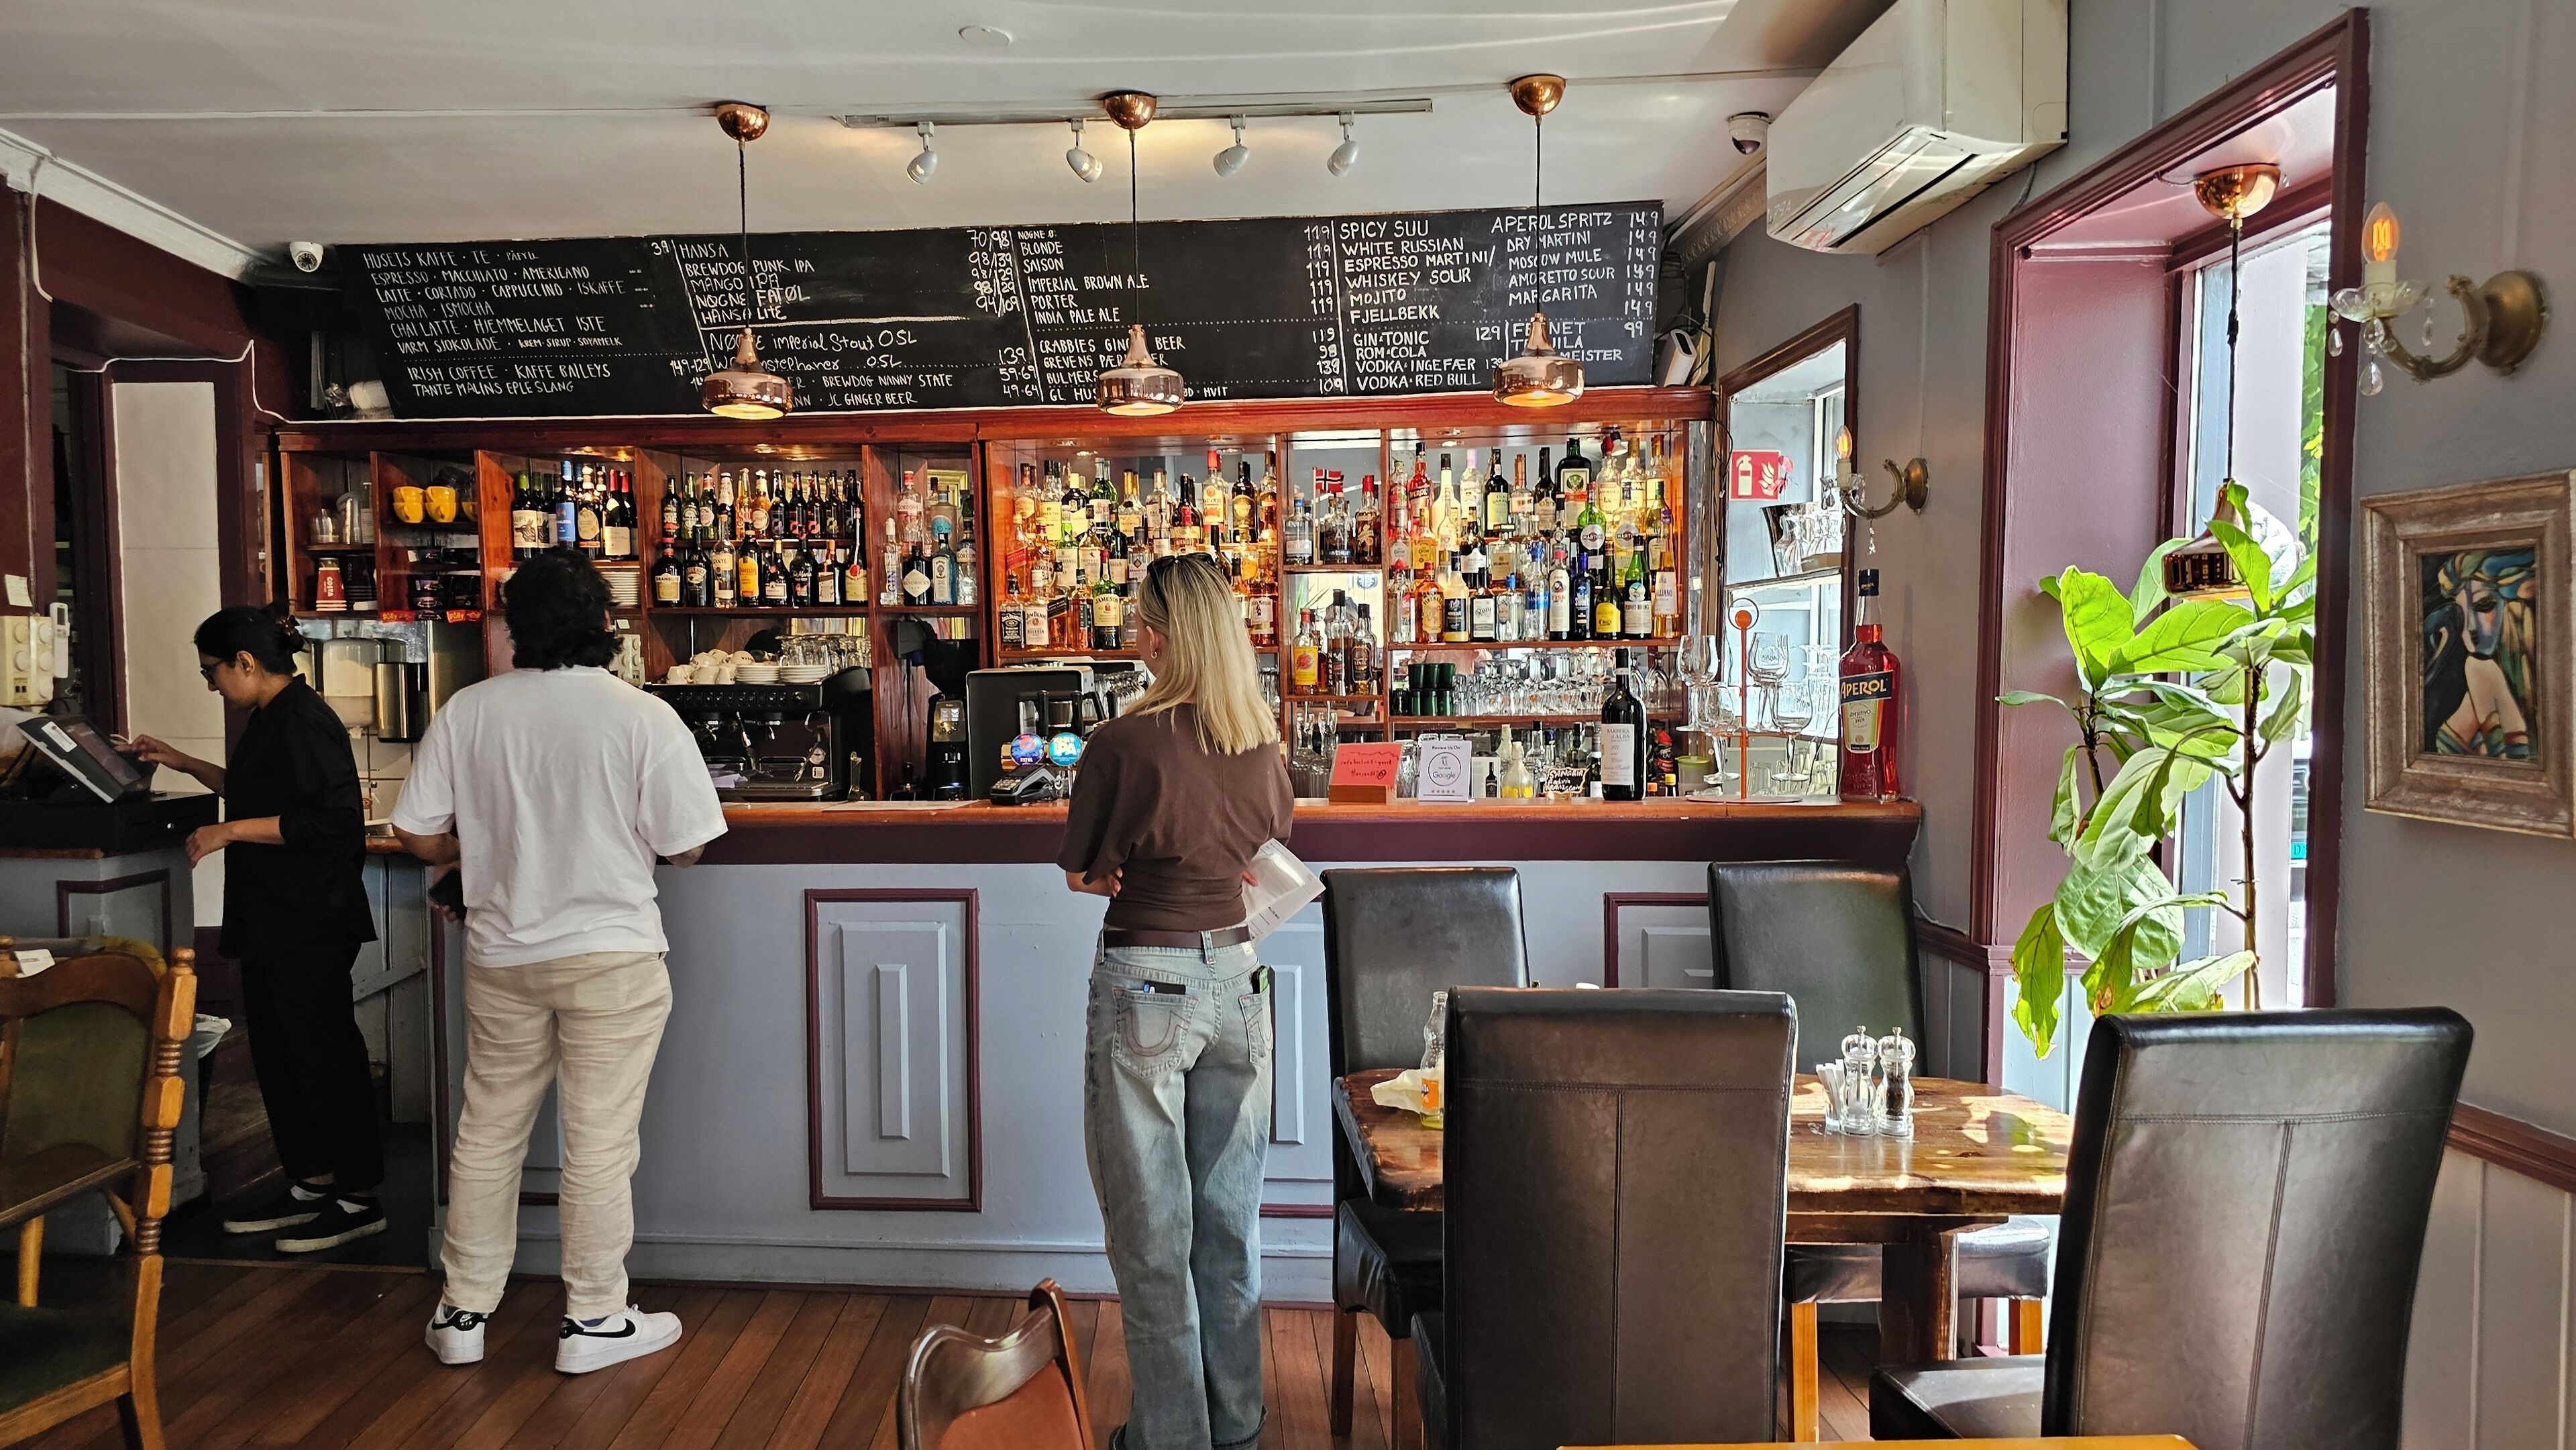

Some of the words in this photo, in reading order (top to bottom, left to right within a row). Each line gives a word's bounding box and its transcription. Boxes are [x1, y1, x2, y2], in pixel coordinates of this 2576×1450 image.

[1339, 221, 1387, 240] SPICY
[1491, 213, 1556, 234] APEROL
[1558, 211, 1613, 229] SPRITZ
[1629, 211, 1658, 228] 149
[1304, 225, 1330, 241] 119
[1506, 236, 1532, 254] DRY
[1628, 229, 1658, 246] 149
[679, 244, 729, 260] HANSA
[1020, 240, 1064, 258] BLONDE
[1307, 243, 1331, 259] 119
[1342, 241, 1394, 258] WHITE
[1401, 237, 1464, 254] RUSSIAN
[363, 252, 411, 269] HUSETS
[417, 250, 458, 267] KAFFE
[472, 250, 490, 265] TE
[684, 262, 746, 278] BREWDOG
[751, 259, 787, 274] PUNK
[794, 258, 815, 273] IPA
[1344, 255, 1419, 273] ESPRESSO
[1508, 252, 1560, 271] MOSCOW
[1565, 248, 1603, 265] MULE
[1627, 246, 1656, 262] 149
[371, 272, 429, 286] ESPRESSO
[441, 268, 508, 283] MACCHIATO
[523, 266, 590, 280] AMERICANO
[1022, 258, 1065, 274] SAISON
[1306, 260, 1330, 279] 119
[1580, 266, 1615, 281] SOUR
[690, 277, 744, 293] MANGO
[749, 272, 780, 289] IPA
[1028, 275, 1079, 294] IMPERIAL
[1083, 273, 1124, 291] BROWN
[1127, 272, 1150, 291] ALE
[1310, 279, 1333, 297] 119
[1345, 270, 1421, 290] WHISKEY
[1430, 267, 1472, 284] SOUR
[375, 287, 412, 303] LATTE
[425, 287, 476, 301] CORTADO
[491, 283, 563, 299] CAPPUCCINO
[577, 280, 625, 295] ISKAFFE
[755, 285, 810, 308] FATØL
[1349, 289, 1407, 308] MOJITO
[1627, 281, 1654, 297] 149
[384, 305, 428, 321] MOCHA
[441, 301, 495, 317] ISMOCHA
[1030, 294, 1079, 311] PORTER
[1310, 297, 1334, 315] 119
[1623, 299, 1653, 317] 149
[700, 309, 753, 326] HANSA
[757, 305, 788, 323] LITE
[1034, 310, 1062, 327] INDIA
[1069, 308, 1095, 325] PALE
[1098, 306, 1120, 323] ALE
[1349, 304, 1440, 325] FJELLBEKK
[390, 323, 417, 338] CHAI
[420, 320, 460, 336] LATTE
[475, 317, 564, 334] HJEMMELAGET
[576, 315, 606, 332] ISTE
[1475, 325, 1502, 342] 129
[1513, 321, 1586, 338] FENET
[1623, 320, 1644, 338] 99
[397, 342, 429, 355] VARM
[434, 337, 501, 353] SJOKOLADE
[1038, 338, 1096, 354] CRABBIES
[1155, 335, 1186, 352] BEER
[1312, 327, 1336, 344] 119
[998, 347, 1027, 365] 139
[1042, 353, 1093, 369] GREVENS
[408, 366, 441, 381] IRISH
[449, 364, 498, 380] COFFEE
[515, 364, 553, 379] KAFFE
[559, 363, 611, 378] BAILEYS
[822, 375, 873, 389] BREWDOG
[879, 374, 912, 388] NANNY
[918, 373, 953, 387] STATE
[1045, 369, 1099, 386] BULMERS
[1446, 372, 1482, 387] BULL
[413, 383, 453, 397] TANTE
[455, 381, 503, 396] MALINS
[506, 381, 533, 395] EPLE
[535, 380, 574, 394] SLANG
[1319, 377, 1344, 395] 109
[827, 393, 842, 407] JC
[845, 393, 884, 407] GINGER
[885, 391, 918, 405] BEER
[1095, 593, 1119, 605] JAMESON
[1840, 679, 1886, 699] APEROL
[1433, 771, 1456, 780] Google
